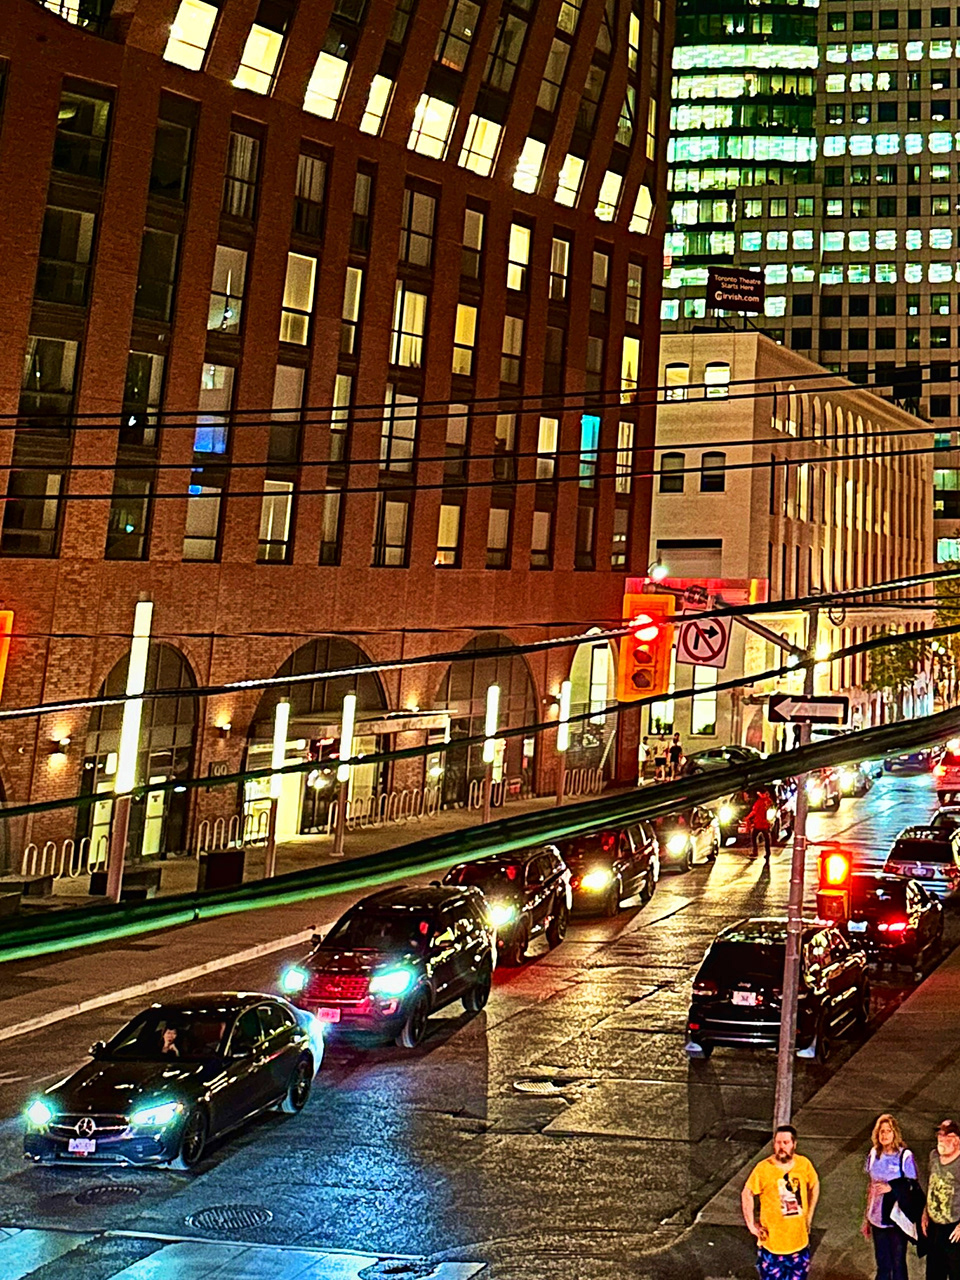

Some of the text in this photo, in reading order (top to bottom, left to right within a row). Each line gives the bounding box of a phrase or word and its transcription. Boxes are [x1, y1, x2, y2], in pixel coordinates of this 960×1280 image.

[714, 274, 761, 285] Toronto Theatre
[721, 282, 738, 290] Starts
